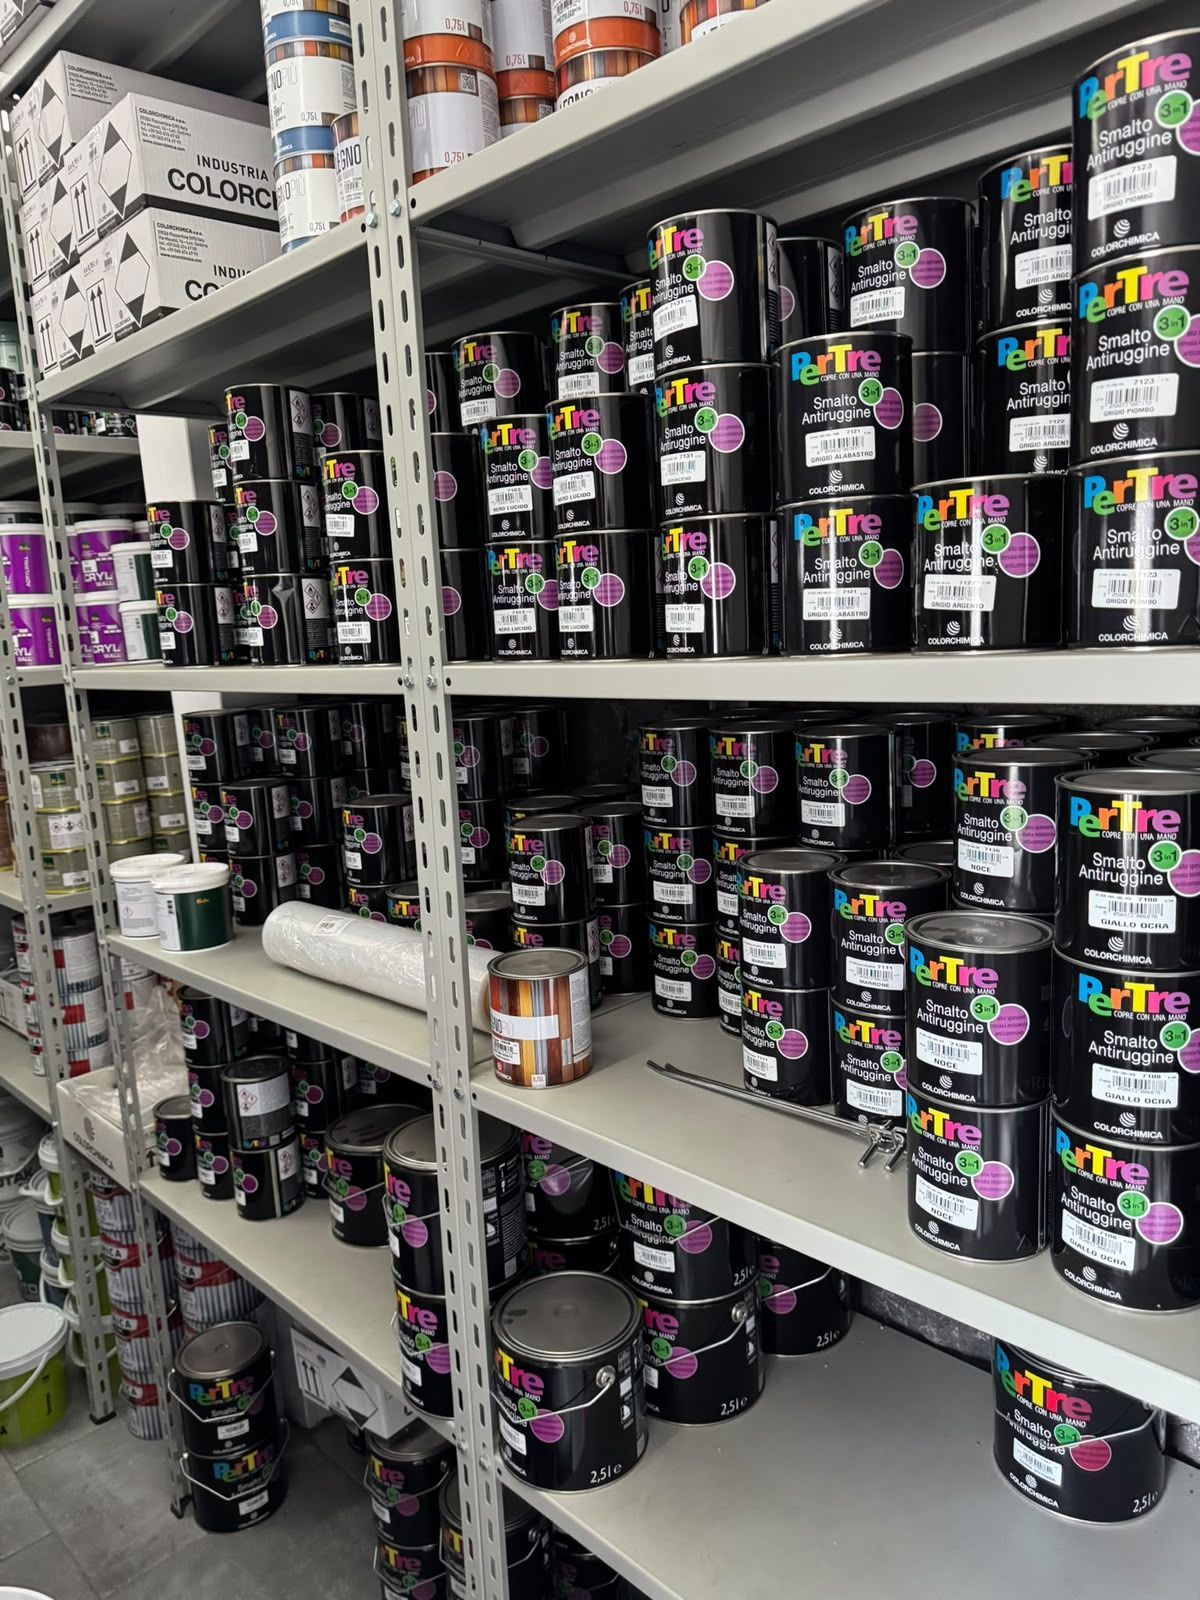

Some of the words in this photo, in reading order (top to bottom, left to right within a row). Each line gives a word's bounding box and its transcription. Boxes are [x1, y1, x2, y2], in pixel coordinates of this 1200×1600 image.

[1079, 50, 1192, 120] PerTre
[1108, 96, 1127, 110] COPRE
[1129, 91, 1144, 102] CON
[1146, 86, 1162, 96] UNA
[1164, 80, 1188, 92] MANO
[1098, 118, 1152, 148] Smalto
[1086, 131, 1172, 172] Antiruggine
[197, 154, 268, 182] INDUSTRIA
[1002, 154, 1072, 202] PerTr
[1024, 209, 1072, 228] Smalto
[846, 212, 918, 257] PerTre
[1091, 231, 1160, 258] COLORCHIMICA
[213, 264, 250, 278] INDU
[858, 260, 893, 278] Smalto
[185, 280, 219, 300] CO
[655, 272, 682, 292] Smalto
[851, 270, 906, 294] Antiruggine
[1026, 275, 1049, 286] GRIGIO
[1079, 266, 1189, 323] PerTre
[1107, 306, 1126, 318] COPRE
[1128, 303, 1142, 313] CON
[1145, 300, 1160, 309] UNA
[1162, 296, 1184, 306] MANO
[998, 328, 1071, 371] PerTr
[1098, 329, 1152, 352] Smalto
[560, 350, 584, 361] Smalto
[791, 344, 882, 386] PerTre
[1086, 344, 1170, 371] Antiruggine
[1020, 380, 1065, 396] Smalto
[813, 394, 857, 410] Smalto
[1006, 392, 1071, 412] Antiruggin
[802, 407, 871, 426] Antiruggine
[1104, 407, 1124, 417] GRIGIO
[664, 424, 694, 440] Smalto
[660, 435, 706, 452] Antiruggine
[1090, 438, 1158, 454] COLORCHIMICA
[555, 448, 581, 461] Smalto
[810, 455, 832, 464] GRIGIO
[834, 450, 874, 460] ALABASTRO
[490, 462, 518, 473] Smalto
[487, 472, 528, 484] Antiruggine
[809, 484, 864, 495] COLORCHIMICA
[1084, 468, 1198, 516] PerTre
[918, 488, 1010, 530] PerTre
[794, 508, 882, 546] PerTre
[1107, 527, 1162, 544] Smalto
[934, 544, 976, 556] Smalto
[1093, 540, 1180, 560] Antiruggine
[814, 558, 857, 570] Smalto
[924, 556, 994, 572] Antiruggine
[498, 584, 524, 594] Smalto
[493, 594, 536, 606] Antiruggine
[810, 642, 864, 650] COLORCHIMICA
[928, 636, 984, 645] COLORCHIMICA
[1098, 632, 1168, 642] COLORCHIMICA
[802, 776, 829, 788] Smalto
[954, 768, 1026, 801] PerTre
[964, 814, 999, 829] Smalto
[1070, 796, 1182, 838] PerTre
[958, 824, 1012, 842] Antiruggine
[1102, 831, 1122, 840] COPRE
[1140, 832, 1154, 840] UNA
[1157, 832, 1177, 840] MANO
[970, 863, 992, 873] NOCE
[1092, 852, 1146, 870] Smalto
[1079, 864, 1164, 888] Antiruggine
[834, 888, 907, 920] PerTre
[960, 891, 1006, 907] COLORCHIMICA
[743, 908, 768, 923] Smalto
[1101, 918, 1136, 929] GIALLO
[849, 930, 884, 944] Smalto
[841, 940, 896, 956] Antiruggine
[1084, 948, 1152, 964] COLORCHIMICA
[910, 946, 999, 990] PerTre
[859, 978, 890, 988] MARRONE
[1078, 973, 1190, 1017] PerTre
[846, 999, 892, 1012] COLORCHIMICA
[926, 999, 968, 1020] Smalto
[917, 1008, 984, 1034] Antiruggine
[1114, 1010, 1134, 1020] COPRE
[1136, 1013, 1150, 1021] CON
[1104, 1030, 1158, 1050] Smalto
[846, 1054, 880, 1070] Smalto
[1088, 1040, 1174, 1066] Antiruggine
[840, 1062, 892, 1082] Antiruggine
[934, 1058, 958, 1070] NOCE
[922, 1082, 976, 1102] COLORCHIMICA
[1105, 1092, 1140, 1103] GIALLO
[1144, 1097, 1172, 1105] OCRA
[858, 1104, 888, 1114] MARRONE
[907, 1093, 982, 1146] PerTre
[1094, 1121, 1163, 1139] COLORCHIMICA
[918, 1146, 954, 1171] Smalto
[1056, 1126, 1150, 1185] PerTre
[912, 1152, 968, 1187] Antiruggine
[1125, 1183, 1144, 1192] MANO
[1070, 1185, 1116, 1214] Smalto
[930, 1208, 954, 1222] NOCE
[1060, 1192, 1132, 1231] Antiruggine
[914, 1223, 960, 1251] COLORCHIMICA
[1070, 1238, 1098, 1257] GIALLO
[1100, 1255, 1126, 1267] OCRA
[1064, 1268, 1122, 1300] COLORCHIMICA
[996, 1343, 1092, 1422] PerTre
[1014, 1408, 1052, 1438] Smalto
[1066, 1417, 1086, 1428] MANO
[1009, 1472, 1058, 1508] COLORCHIMICA
